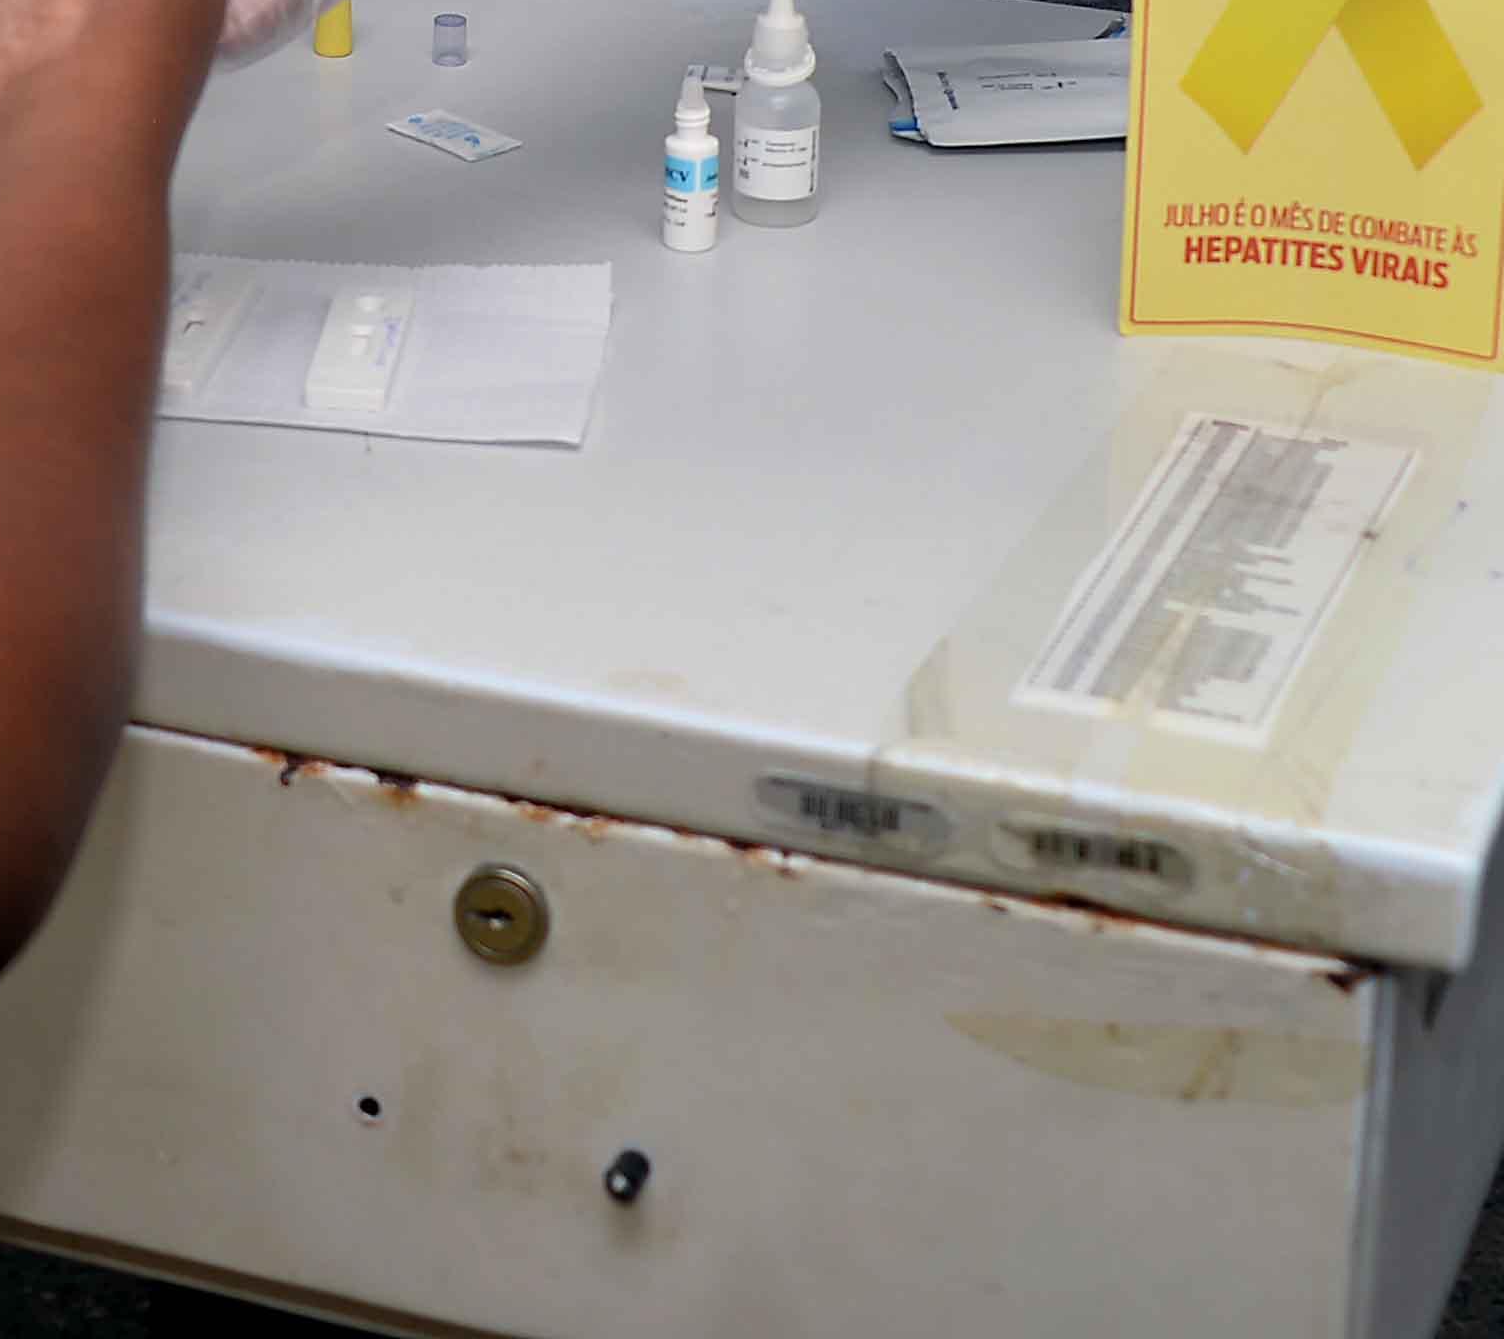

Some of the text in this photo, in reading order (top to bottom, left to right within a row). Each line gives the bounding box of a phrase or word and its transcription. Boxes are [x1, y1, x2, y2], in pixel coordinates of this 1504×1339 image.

[1163, 197, 1479, 258] JULHO É O MÊS DE COMBATE ÀS
[1183, 235, 1450, 289] HEPATITES VIRAIS
